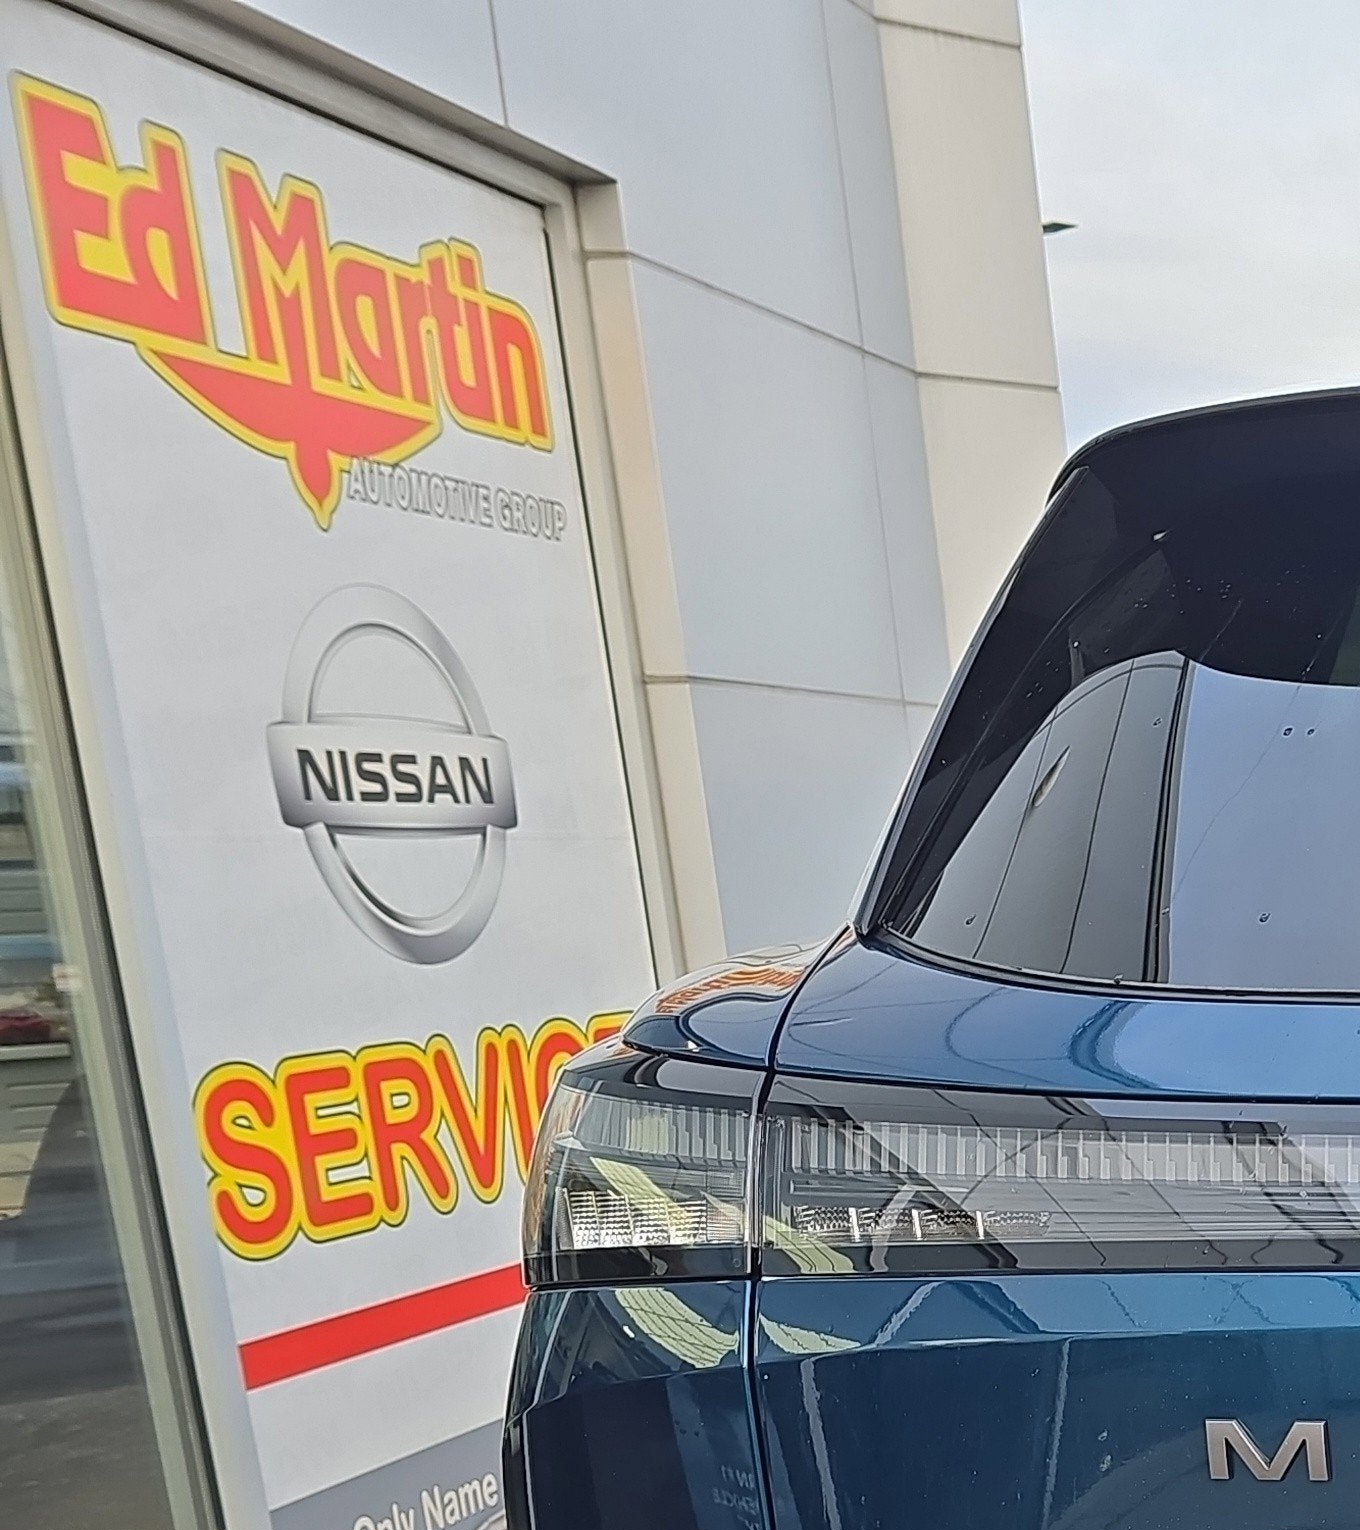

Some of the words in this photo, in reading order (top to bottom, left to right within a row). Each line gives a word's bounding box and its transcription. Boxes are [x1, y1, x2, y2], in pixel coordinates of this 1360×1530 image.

[11, 71, 213, 350] Ed
[217, 148, 556, 452] Martin
[347, 456, 495, 528] AUTOMOTIVE
[495, 486, 568, 542] GROUP
[297, 746, 495, 806] NISSAN
[195, 1010, 637, 1261] SERVIC
